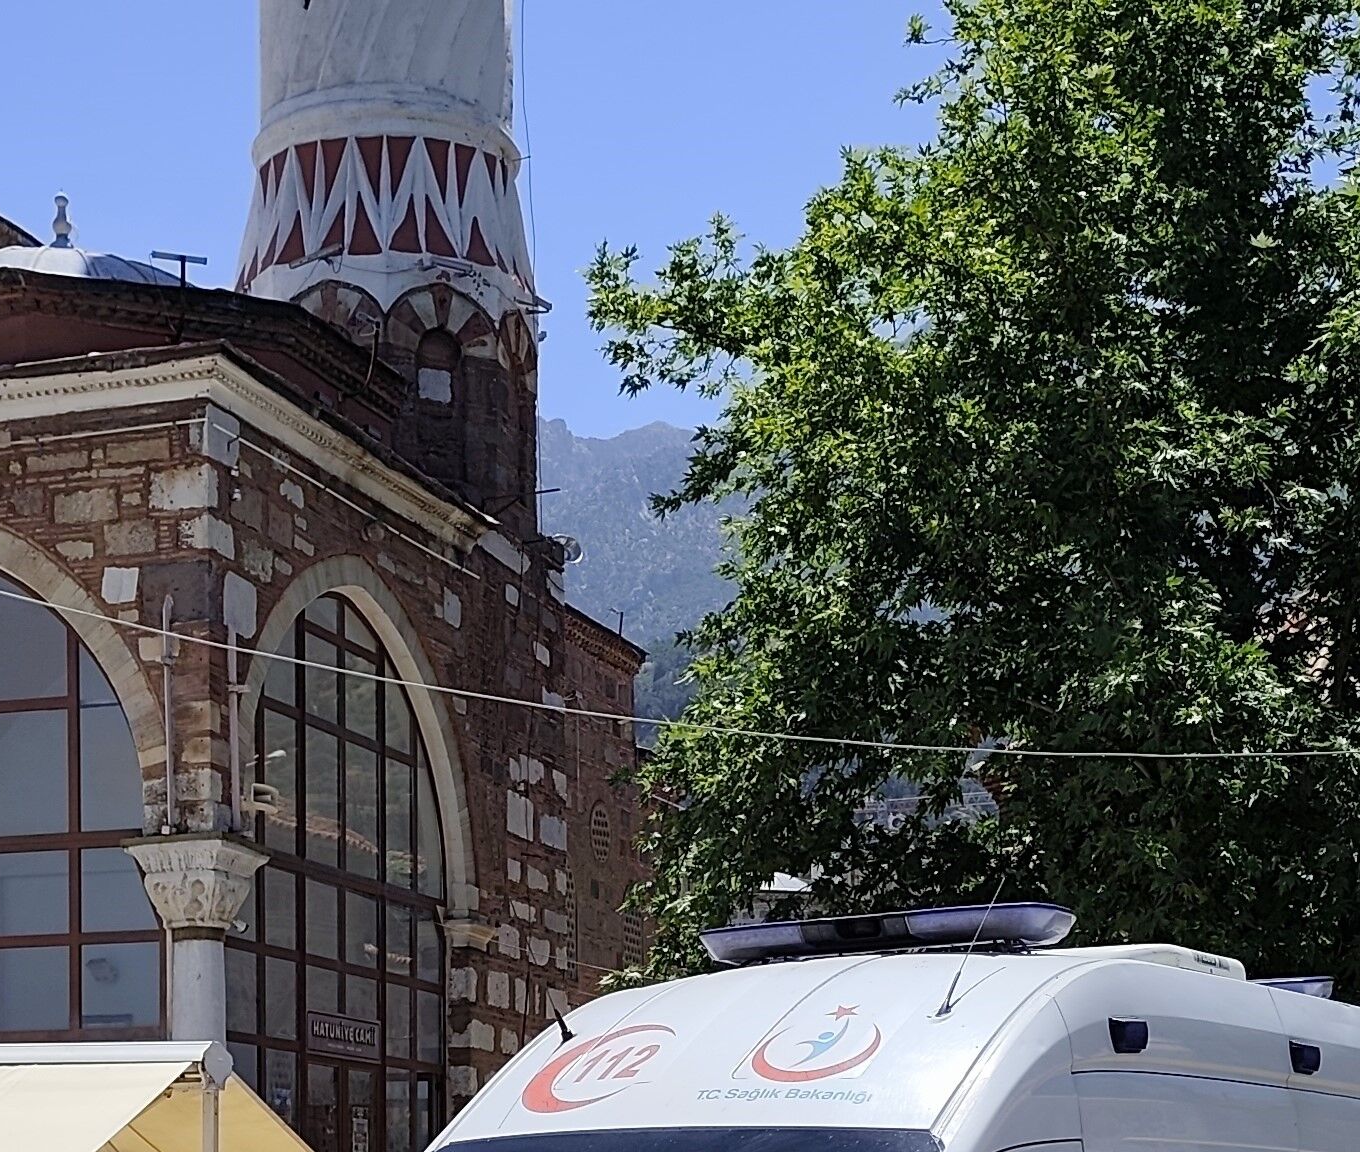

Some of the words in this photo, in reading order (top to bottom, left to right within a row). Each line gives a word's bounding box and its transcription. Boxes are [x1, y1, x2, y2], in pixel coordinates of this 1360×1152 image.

[573, 1044, 661, 1083] 112
[724, 1088, 781, 1102] Sağlık
[784, 1088, 873, 1105] Bakanlığı
